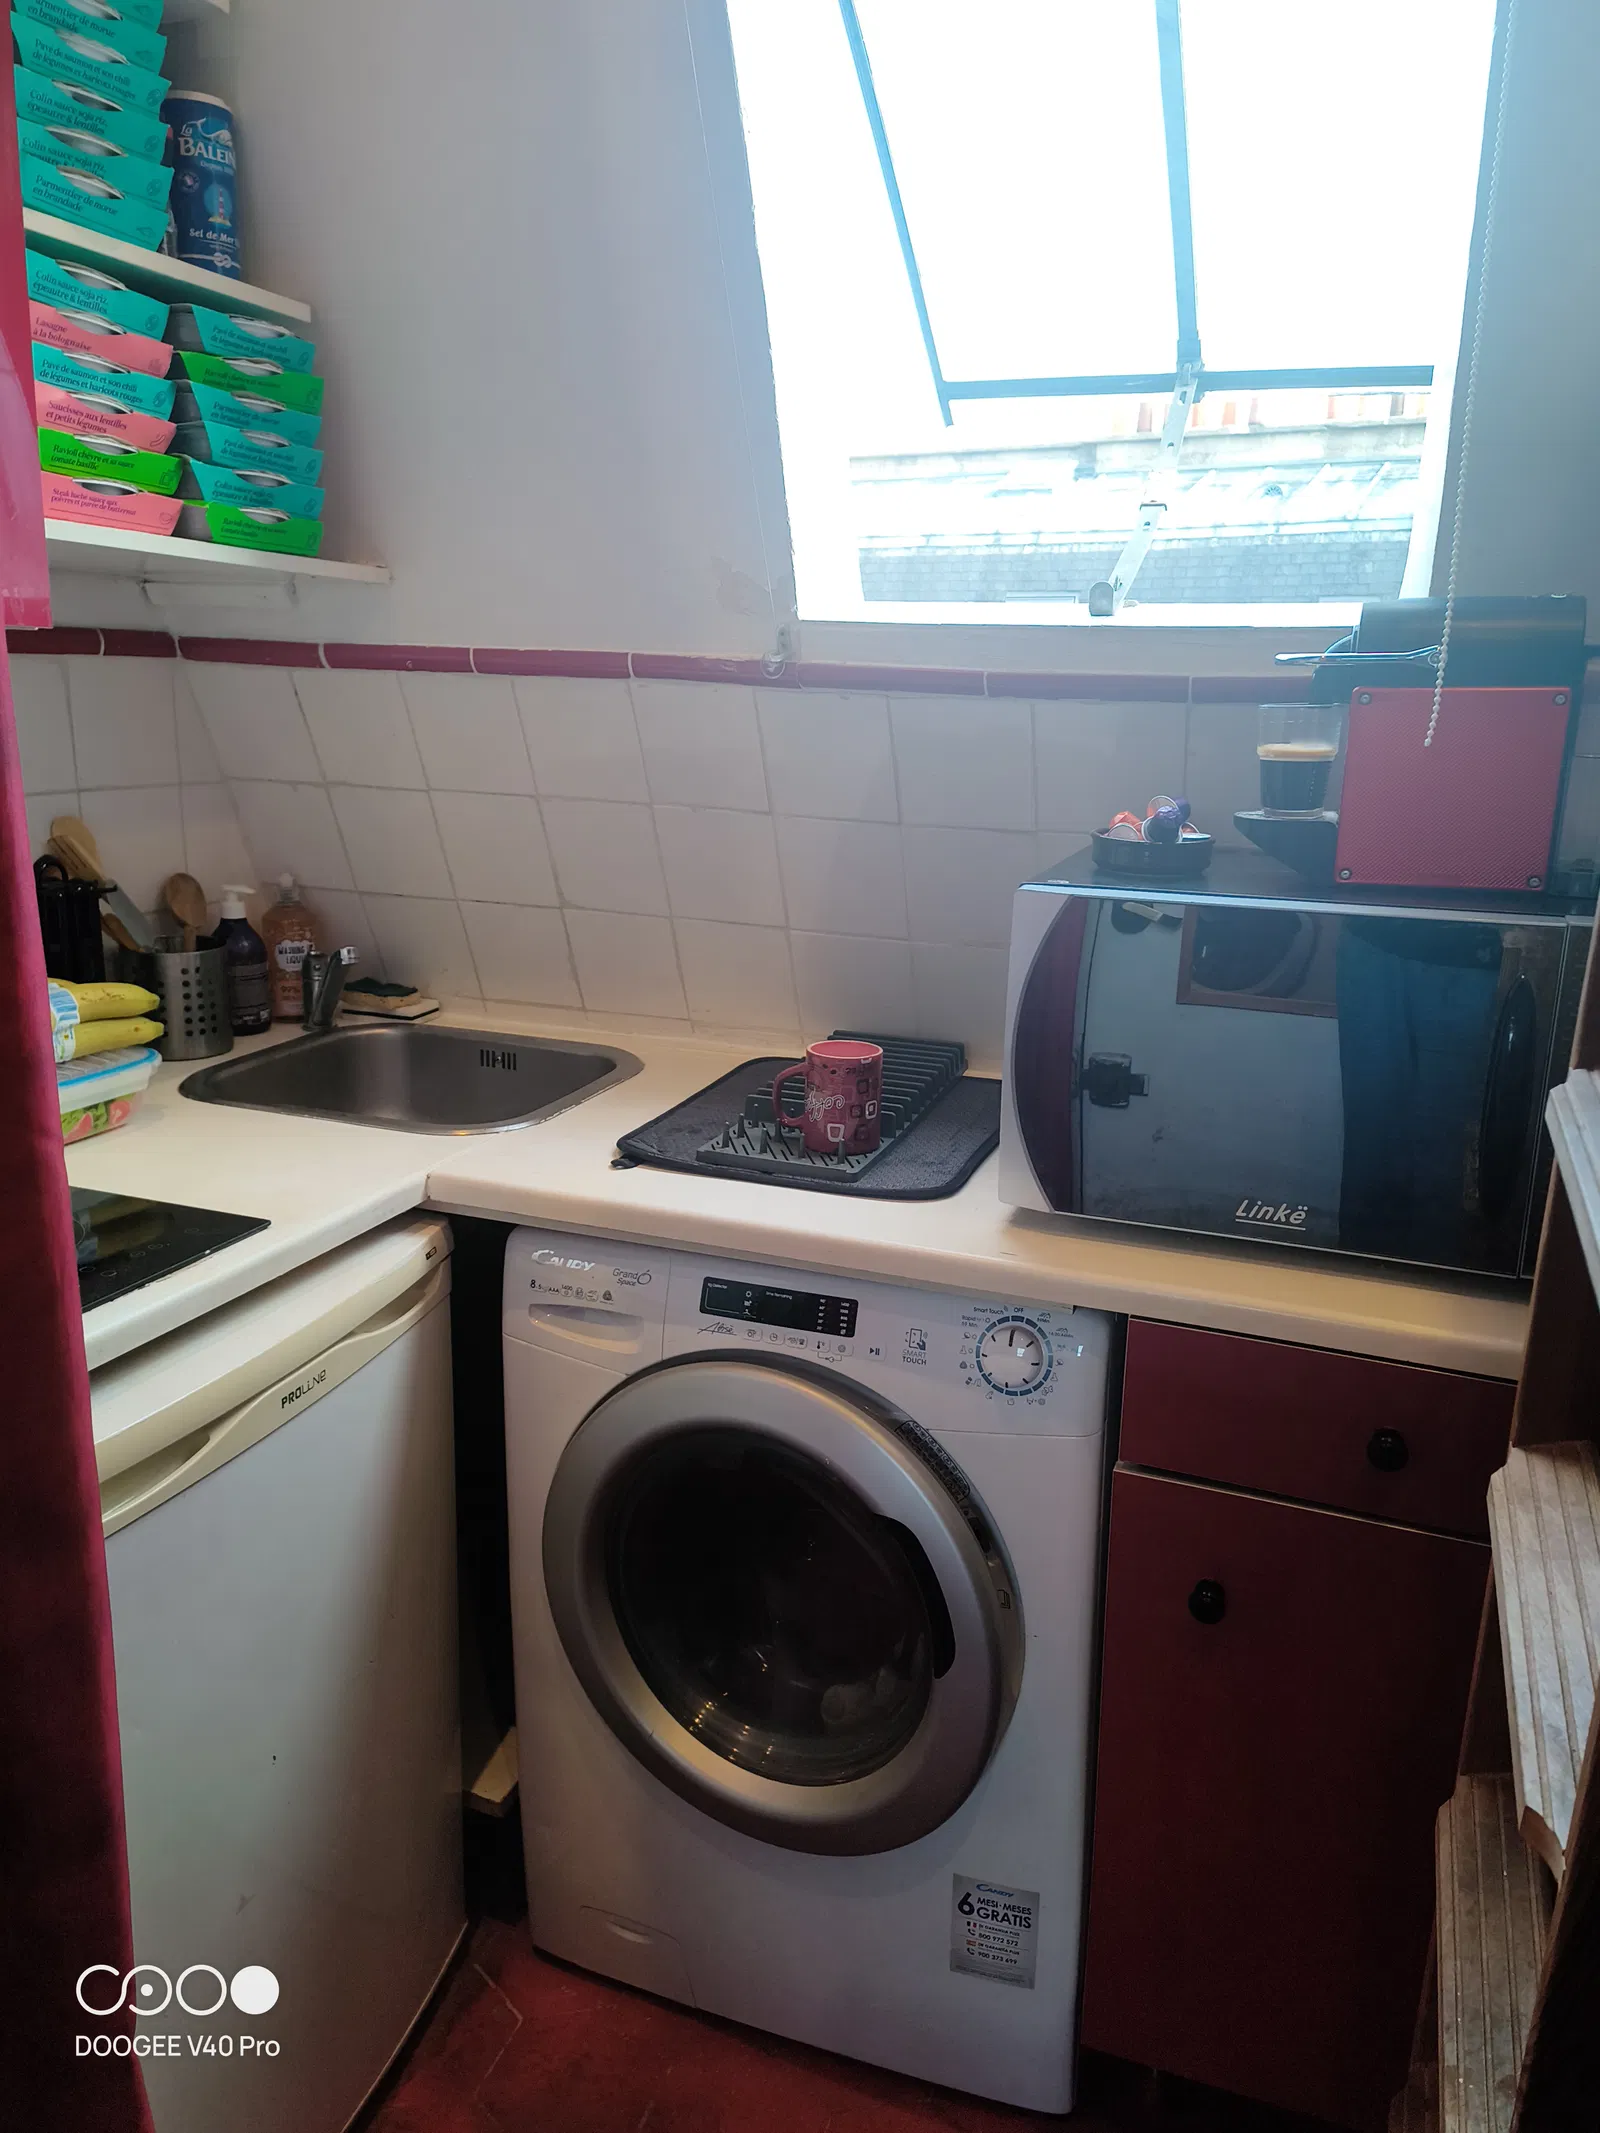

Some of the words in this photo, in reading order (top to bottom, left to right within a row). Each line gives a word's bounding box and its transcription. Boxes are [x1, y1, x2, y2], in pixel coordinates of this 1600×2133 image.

[30, 90, 53, 104] Colin
[180, 123, 193, 137] La
[22, 137, 46, 151] Colin
[178, 137, 237, 170] BALEIN
[32, 186, 43, 196] en
[36, 174, 83, 201] Parmentier
[83, 195, 94, 206] de
[189, 228, 204, 238] Sel
[205, 230, 218, 241] de
[36, 270, 57, 284] Colin
[58, 281, 79, 294] sauce
[80, 289, 95, 302] soja
[77, 295, 108, 314] lentilles
[35, 316, 68, 333] Lasagne
[47, 331, 92, 351] bolognaise
[61, 364, 70, 373] de
[70, 369, 99, 381] saumon
[108, 379, 121, 388] son
[122, 383, 138, 393] chili
[40, 369, 49, 378] de
[49, 370, 80, 386] légumes
[89, 382, 119, 397] haricots
[119, 392, 144, 403] rouges
[48, 400, 83, 416] Saucisses
[84, 411, 99, 420] aux
[99, 414, 127, 430] lentilles
[53, 413, 75, 424] petits
[75, 418, 107, 434] légumes
[53, 444, 78, 457] Ravioli
[52, 488, 69, 498] Steak
[278, 945, 307, 954] WASHING
[286, 955, 303, 965] LIQU
[1236, 1200, 1309, 1224] Linkë
[612, 1268, 638, 1280] Grand
[617, 1277, 637, 1287] Space
[973, 1306, 989, 1314] Smart
[989, 1307, 1004, 1315] Touch
[902, 1349, 927, 1358] SMART
[902, 1356, 927, 1365] TOUCH
[957, 1891, 975, 1915] 6
[976, 1907, 1031, 1929] GRATIS
[992, 1936, 1005, 1944] 972
[1006, 1939, 1019, 1947] 572
